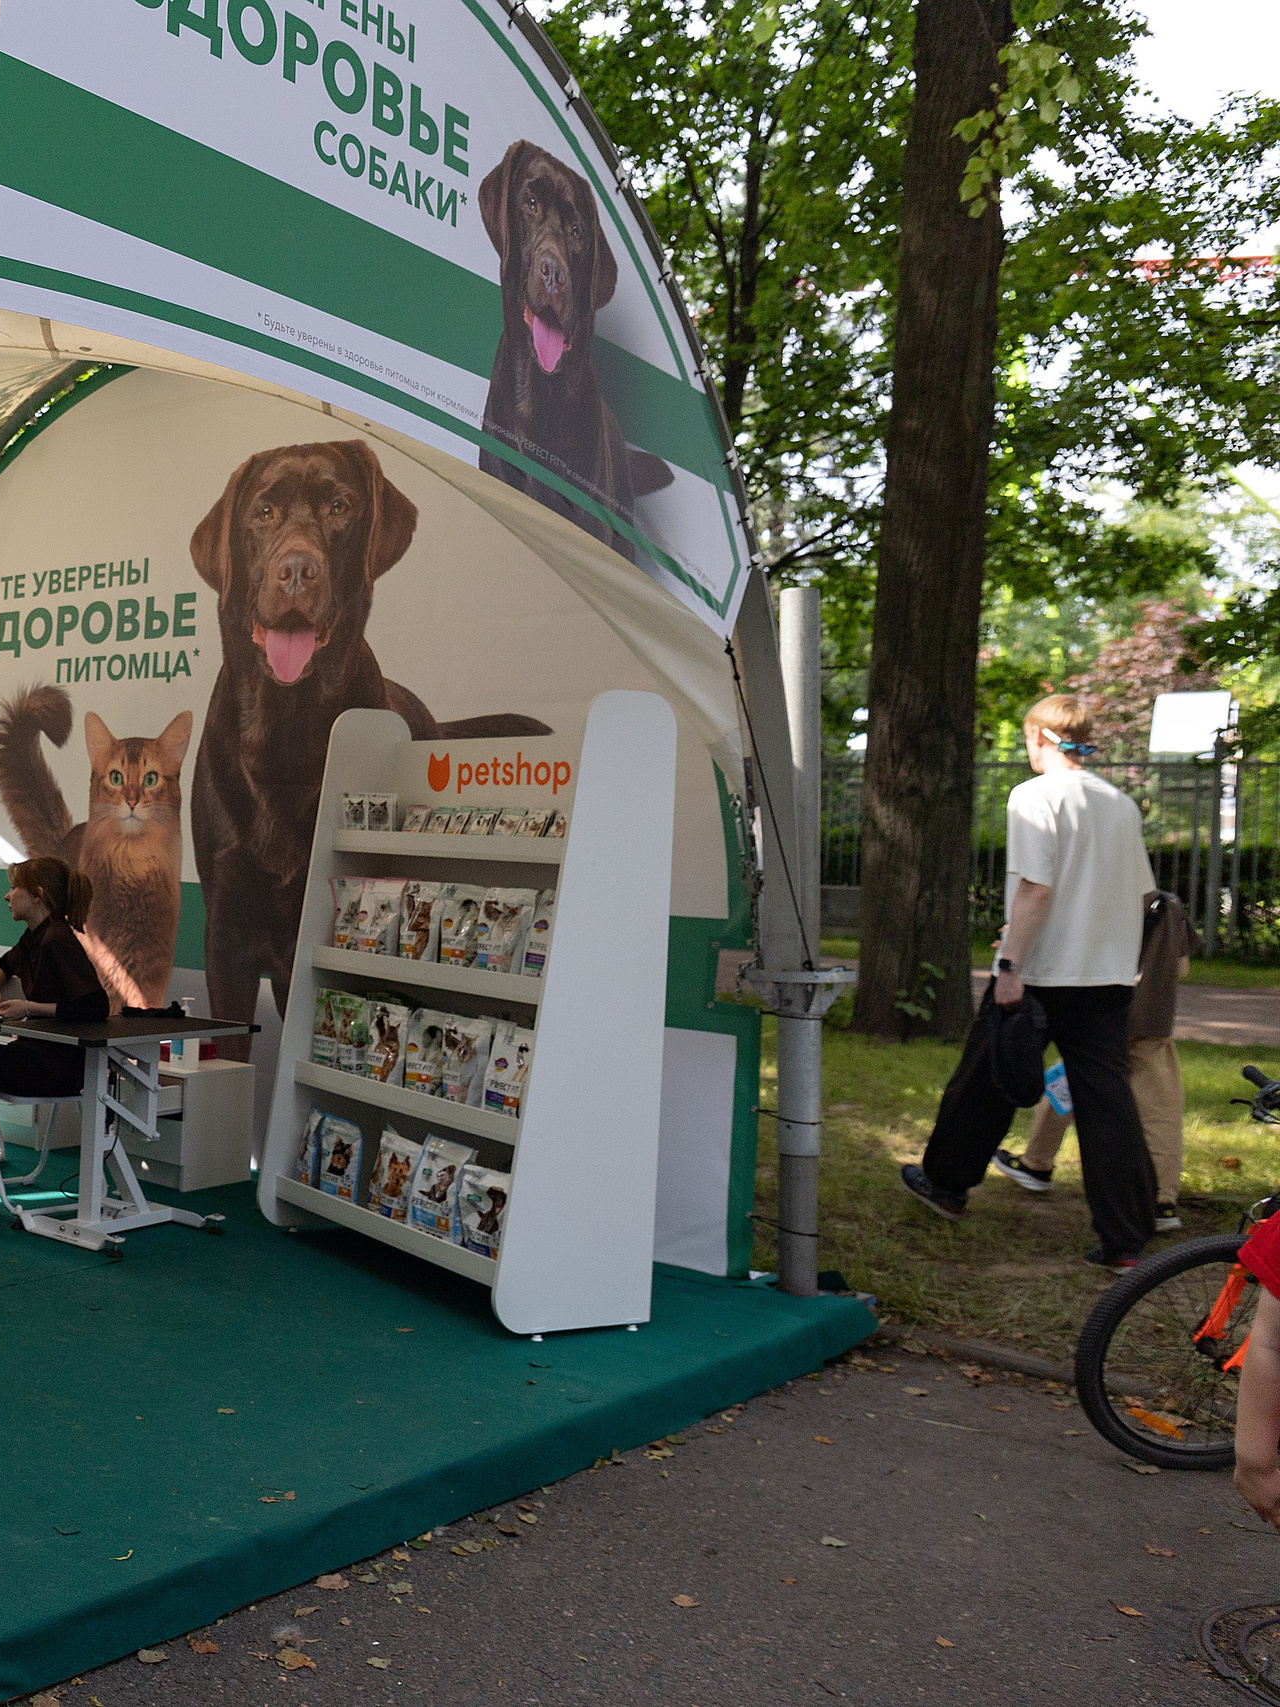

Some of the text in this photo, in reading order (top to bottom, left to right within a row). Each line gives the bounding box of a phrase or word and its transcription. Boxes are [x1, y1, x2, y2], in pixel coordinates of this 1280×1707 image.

[305, 0, 415, 63] ЕНЫ
[133, 0, 470, 178] ДОРОВЬЕ
[263, 313, 295, 336] Будьте
[297, 329, 336, 354] уверены
[344, 348, 384, 373] здоровье
[385, 366, 419, 391] питомца
[421, 384, 436, 399] при
[437, 392, 479, 420] кормлении
[32, 557, 150, 597] УВЕРЕНЫ
[456, 751, 571, 795] petshop
